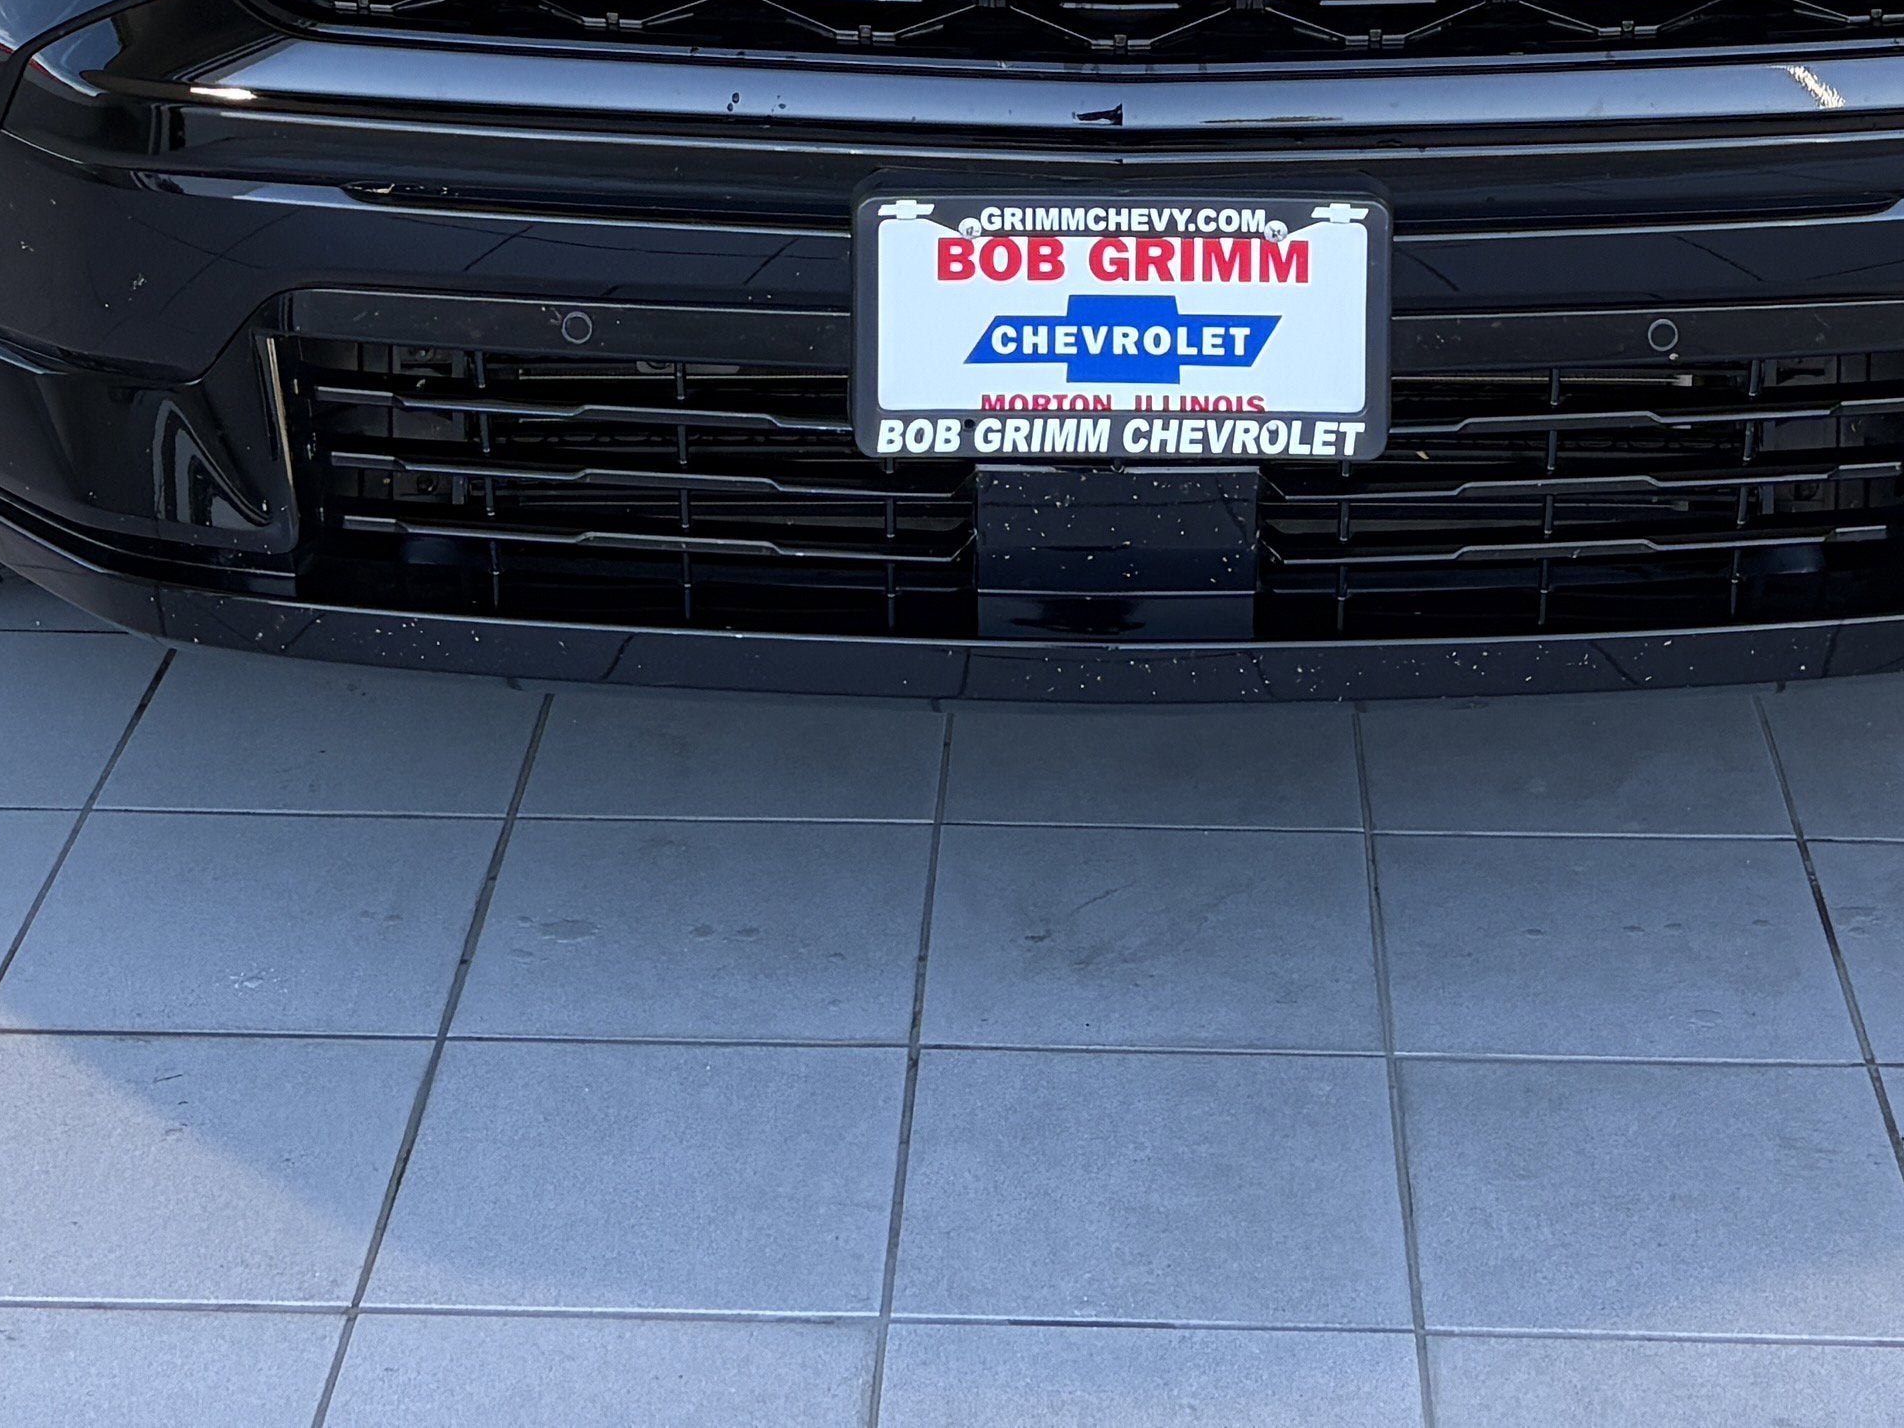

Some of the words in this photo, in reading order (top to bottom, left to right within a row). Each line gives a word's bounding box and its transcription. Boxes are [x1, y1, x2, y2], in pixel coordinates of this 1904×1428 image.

[979, 205, 1266, 234] GRIMMCHEVY.COM
[936, 236, 1066, 282] BOB
[1088, 236, 1310, 284] GRIMM
[991, 324, 1251, 357] CHEVROLET
[981, 394, 1112, 412] MORTON
[876, 418, 963, 454] BOB
[973, 418, 1108, 454] GRIMM
[1122, 420, 1366, 458] CHEVROLET
